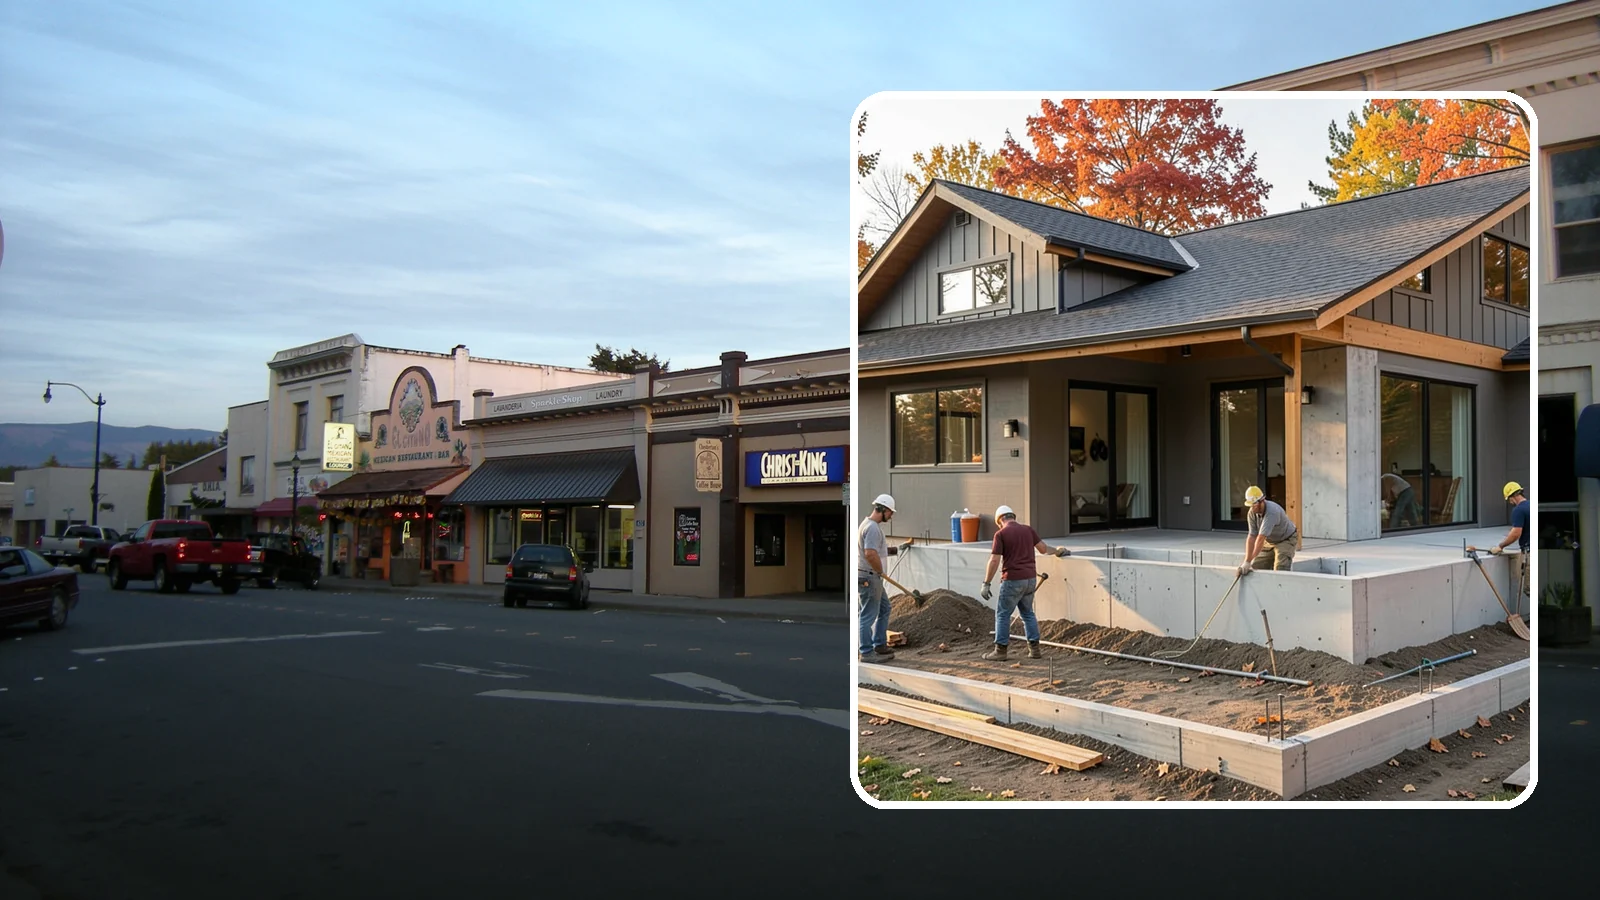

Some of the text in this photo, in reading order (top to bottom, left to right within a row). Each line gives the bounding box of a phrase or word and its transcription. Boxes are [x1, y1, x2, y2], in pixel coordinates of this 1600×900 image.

[493, 389, 623, 412] LAVANDERIA Sparkle Shop LAUNDRY
[374, 455, 396, 464] MEXICAN
[398, 451, 433, 462] RESTAURANT
[437, 450, 450, 459] BAR
[761, 450, 827, 478] CHRIST KING
